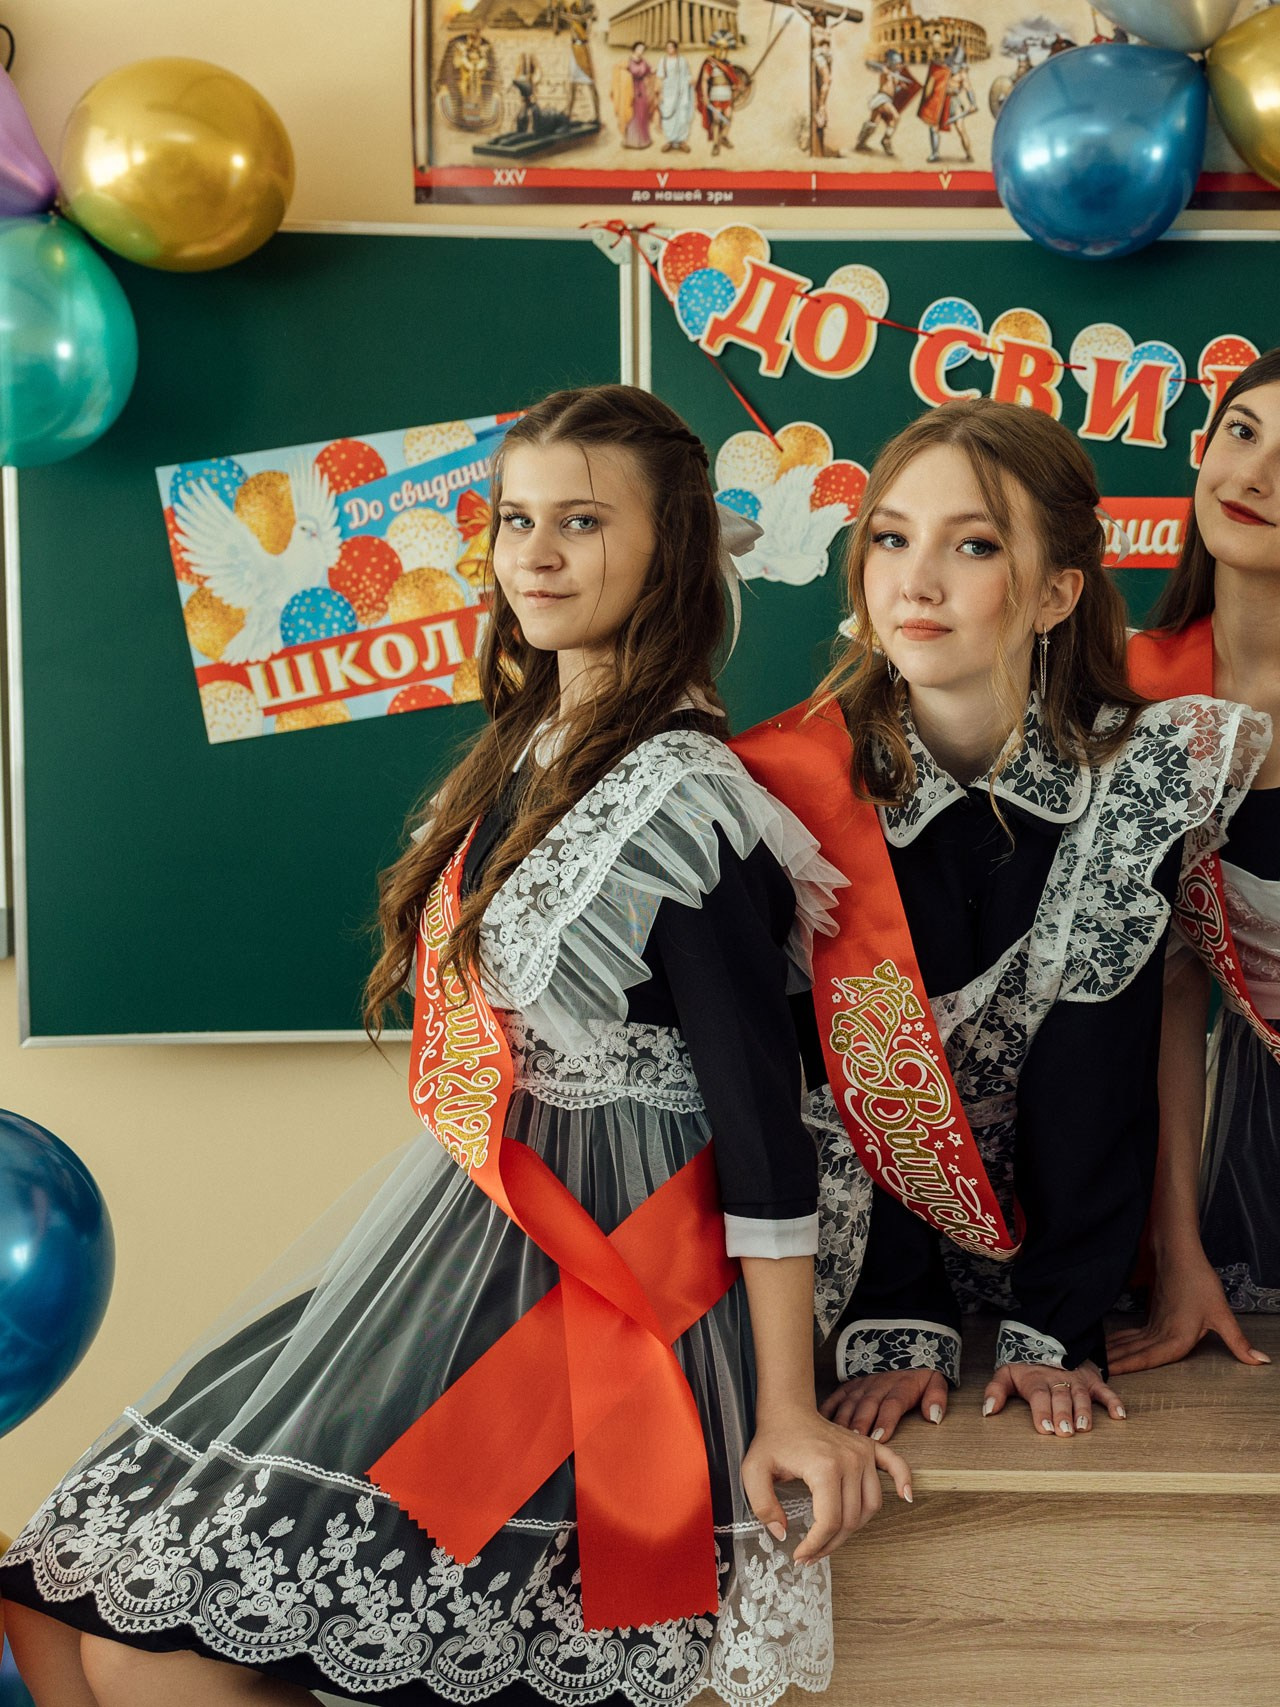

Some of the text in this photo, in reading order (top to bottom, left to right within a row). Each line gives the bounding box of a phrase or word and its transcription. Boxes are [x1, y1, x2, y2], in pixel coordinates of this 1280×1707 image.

[493, 169, 527, 186] XXV
[656, 172, 669, 189] V
[939, 174, 953, 190] V
[631, 189, 734, 205] до нашей эры
[699, 259, 876, 379] ДО
[343, 497, 385, 530] До
[850, 1046, 1003, 1250] Выпуск
